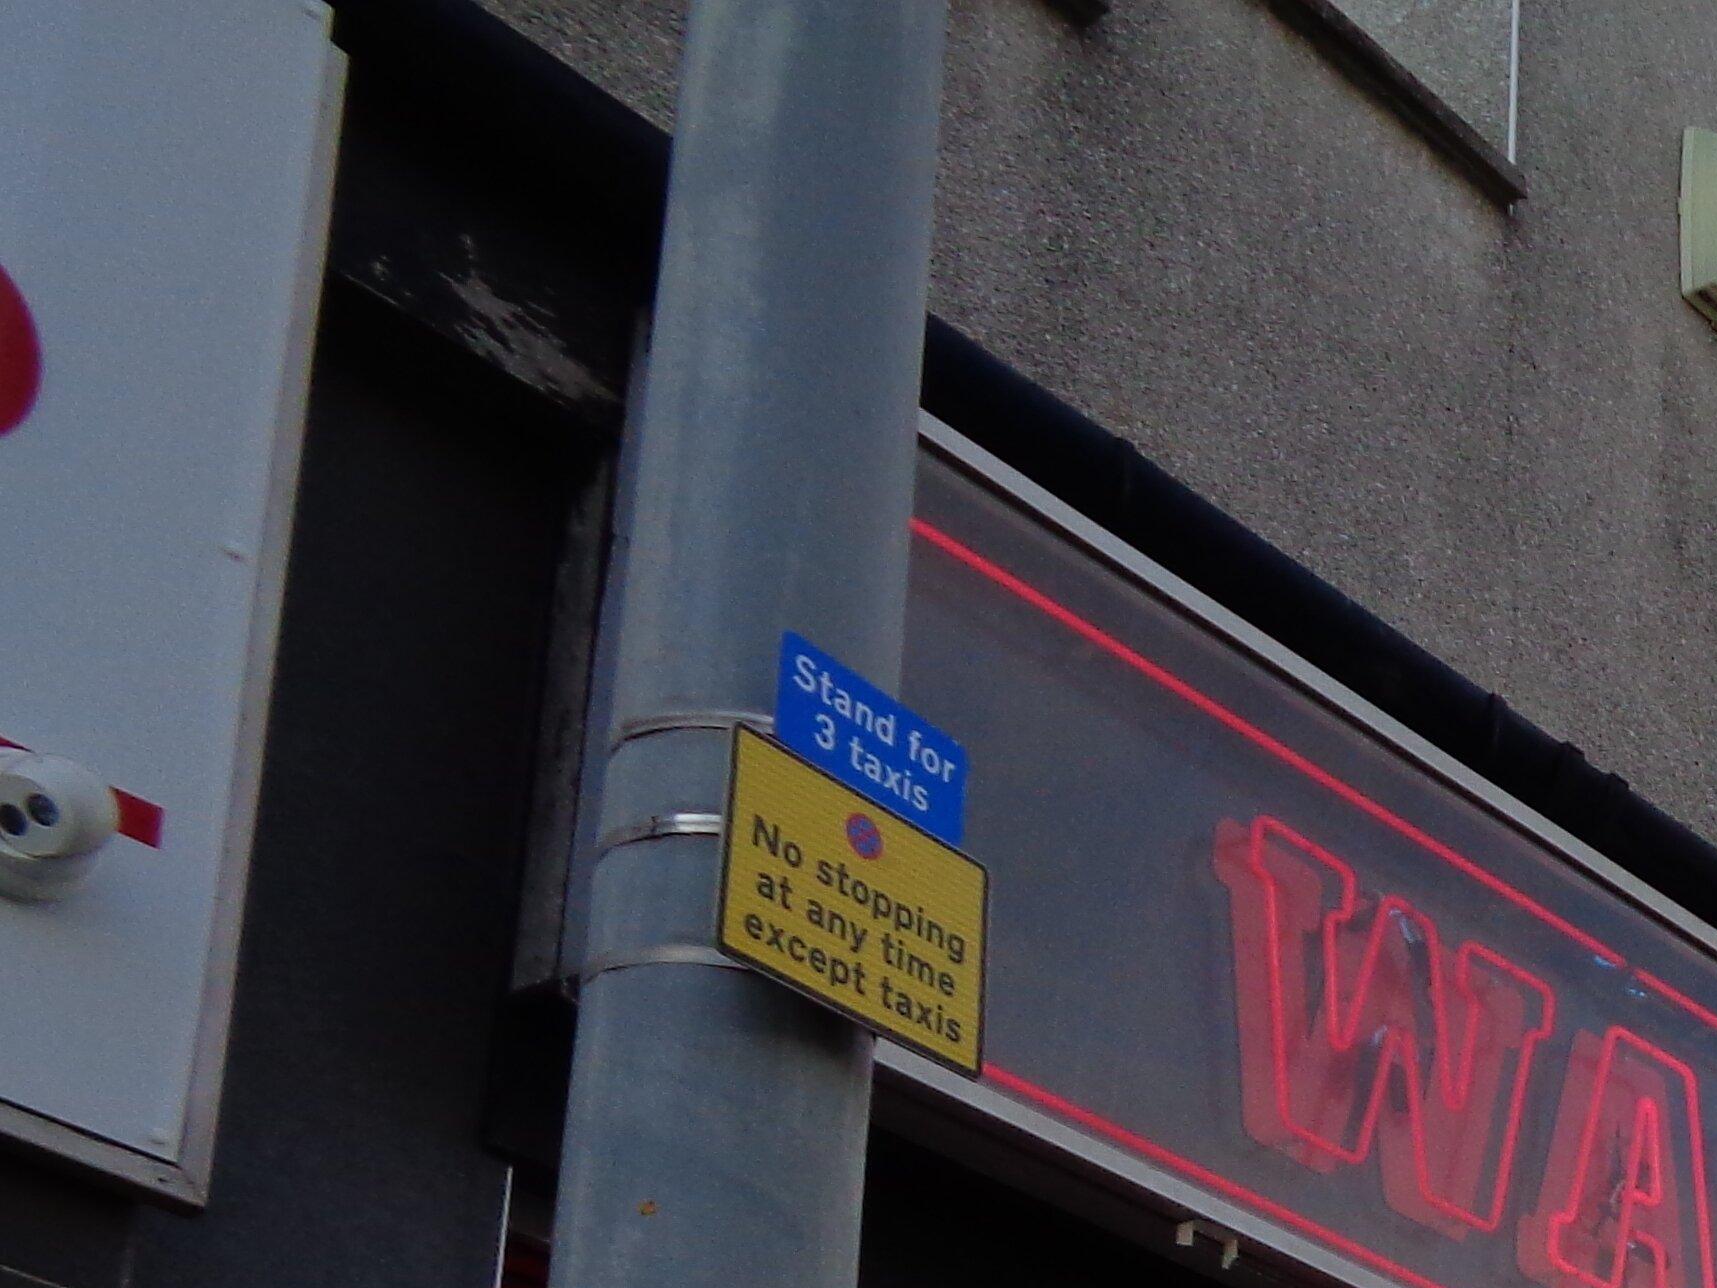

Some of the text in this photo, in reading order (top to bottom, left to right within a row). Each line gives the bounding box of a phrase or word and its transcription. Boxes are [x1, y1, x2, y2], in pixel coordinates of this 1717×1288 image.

[793, 654, 956, 784] Stand for
[814, 714, 930, 812] 3 taxis
[751, 814, 967, 966] No stopping
[756, 871, 957, 997] at any time
[744, 911, 962, 1045] except taxis
